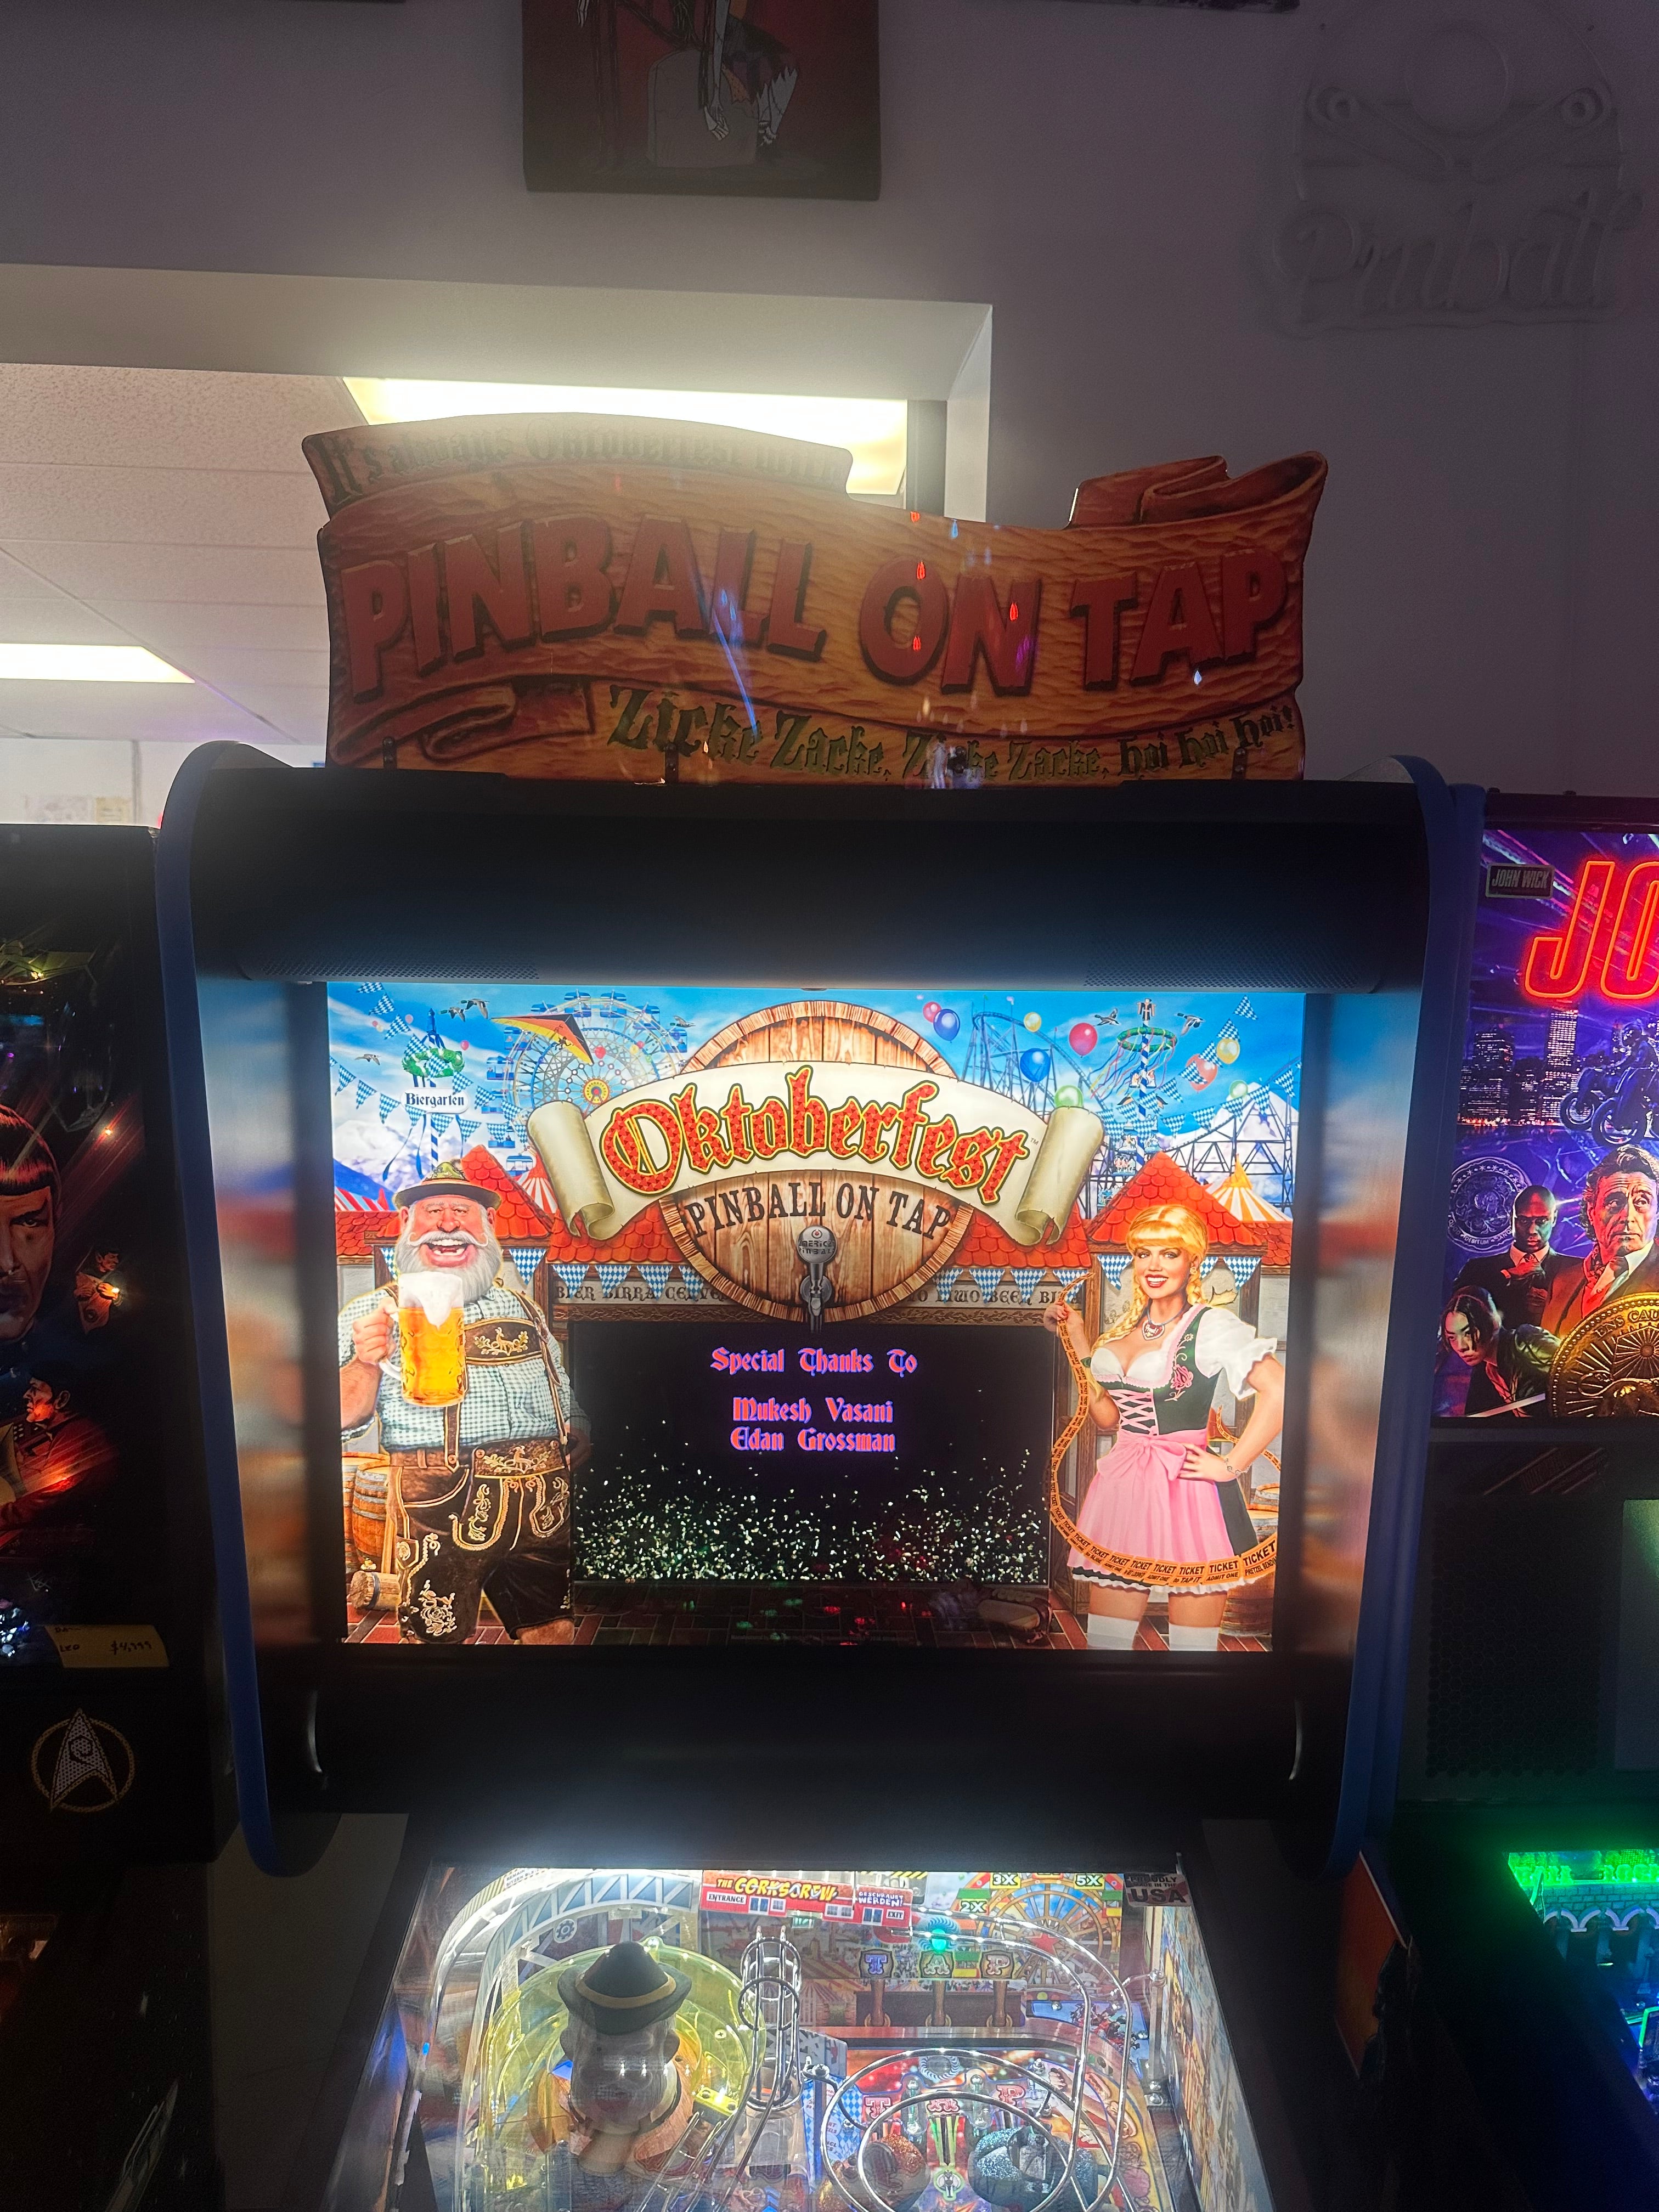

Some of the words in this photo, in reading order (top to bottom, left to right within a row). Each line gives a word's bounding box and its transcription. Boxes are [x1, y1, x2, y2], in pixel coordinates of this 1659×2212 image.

[340, 512, 827, 703] PINBALL
[859, 554, 1042, 697] ON
[1069, 549, 1288, 691] TAP
[902, 730, 999, 780] Zke
[1491, 868, 1522, 888] JOHN
[1521, 870, 1552, 890] WICK
[405, 1092, 465, 1108] Biergarten
[599, 1065, 1033, 1206] Oktoberfest
[683, 1181, 826, 1239] PINBALL
[835, 1182, 876, 1221] ON
[888, 1189, 951, 1241] TAP
[710, 1346, 786, 1374] Special
[797, 1347, 874, 1376] Thanks
[886, 1348, 918, 1377] To
[732, 1397, 812, 1423] Mukesh
[825, 1397, 894, 1423] Vasani
[730, 1426, 785, 1452] Edan
[797, 1427, 896, 1453] Grossman
[1074, 1532, 1091, 1548] TICKET
[1090, 1545, 1110, 1559] TICKET
[1243, 1539, 1276, 1566] TICKET
[1109, 1555, 1131, 1566] TICKET
[1130, 1560, 1153, 1570] TICKET
[1209, 1560, 1238, 1573] TICKET
[1153, 1564, 1177, 1574] TICKET
[1178, 1566, 1205, 1575] TICKET
[1245, 1565, 1263, 1576] PRETZEL
[1206, 1573, 1226, 1582] ADMIT
[716, 1878, 733, 1889] THE
[992, 1874, 1019, 1887] 3X
[1075, 1874, 1104, 1887] 5X
[708, 1894, 745, 1904] ENTRANCE
[858, 1897, 904, 1908] WERDEN!
[1131, 1888, 1187, 1904] USA
[960, 1900, 987, 1914] 2X
[887, 1911, 904, 1919] EXIT
[865, 1954, 888, 1975] T
[923, 1953, 951, 1976] A
[986, 1954, 1011, 1976] P
